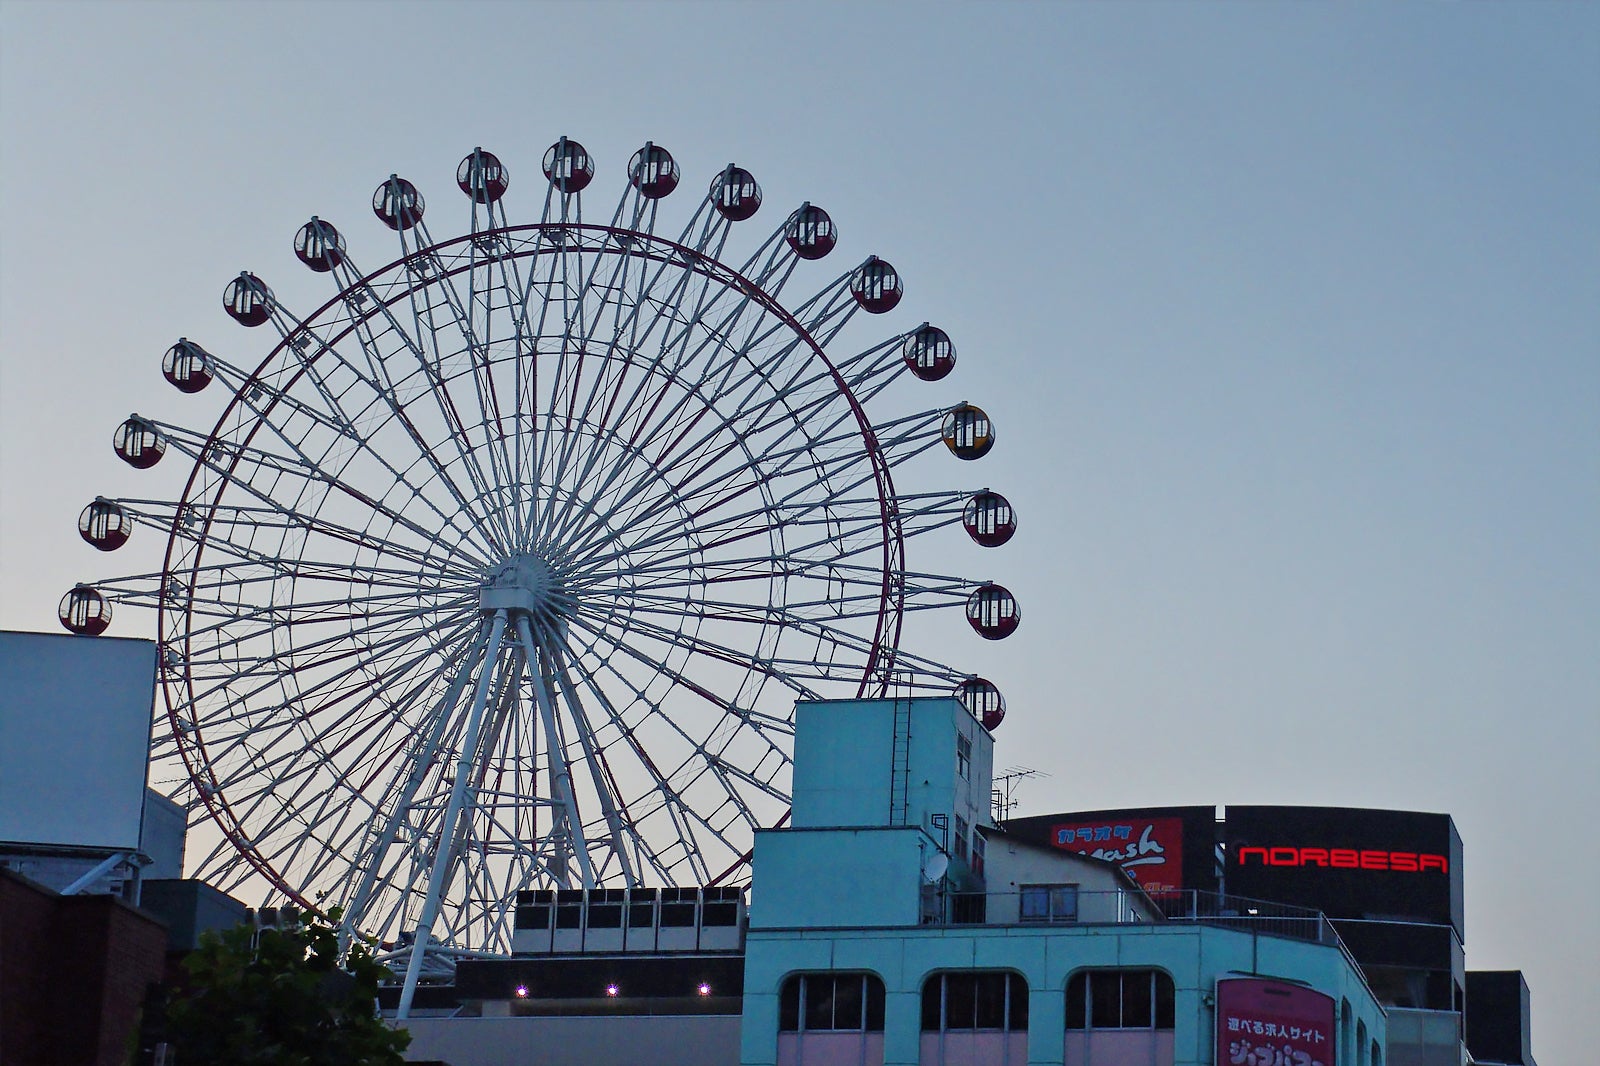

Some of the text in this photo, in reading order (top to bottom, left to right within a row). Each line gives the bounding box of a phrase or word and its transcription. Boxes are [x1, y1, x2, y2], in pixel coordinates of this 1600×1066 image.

[1058, 825, 1132, 844] カラオケ
[1239, 846, 1448, 874] NORBESA
